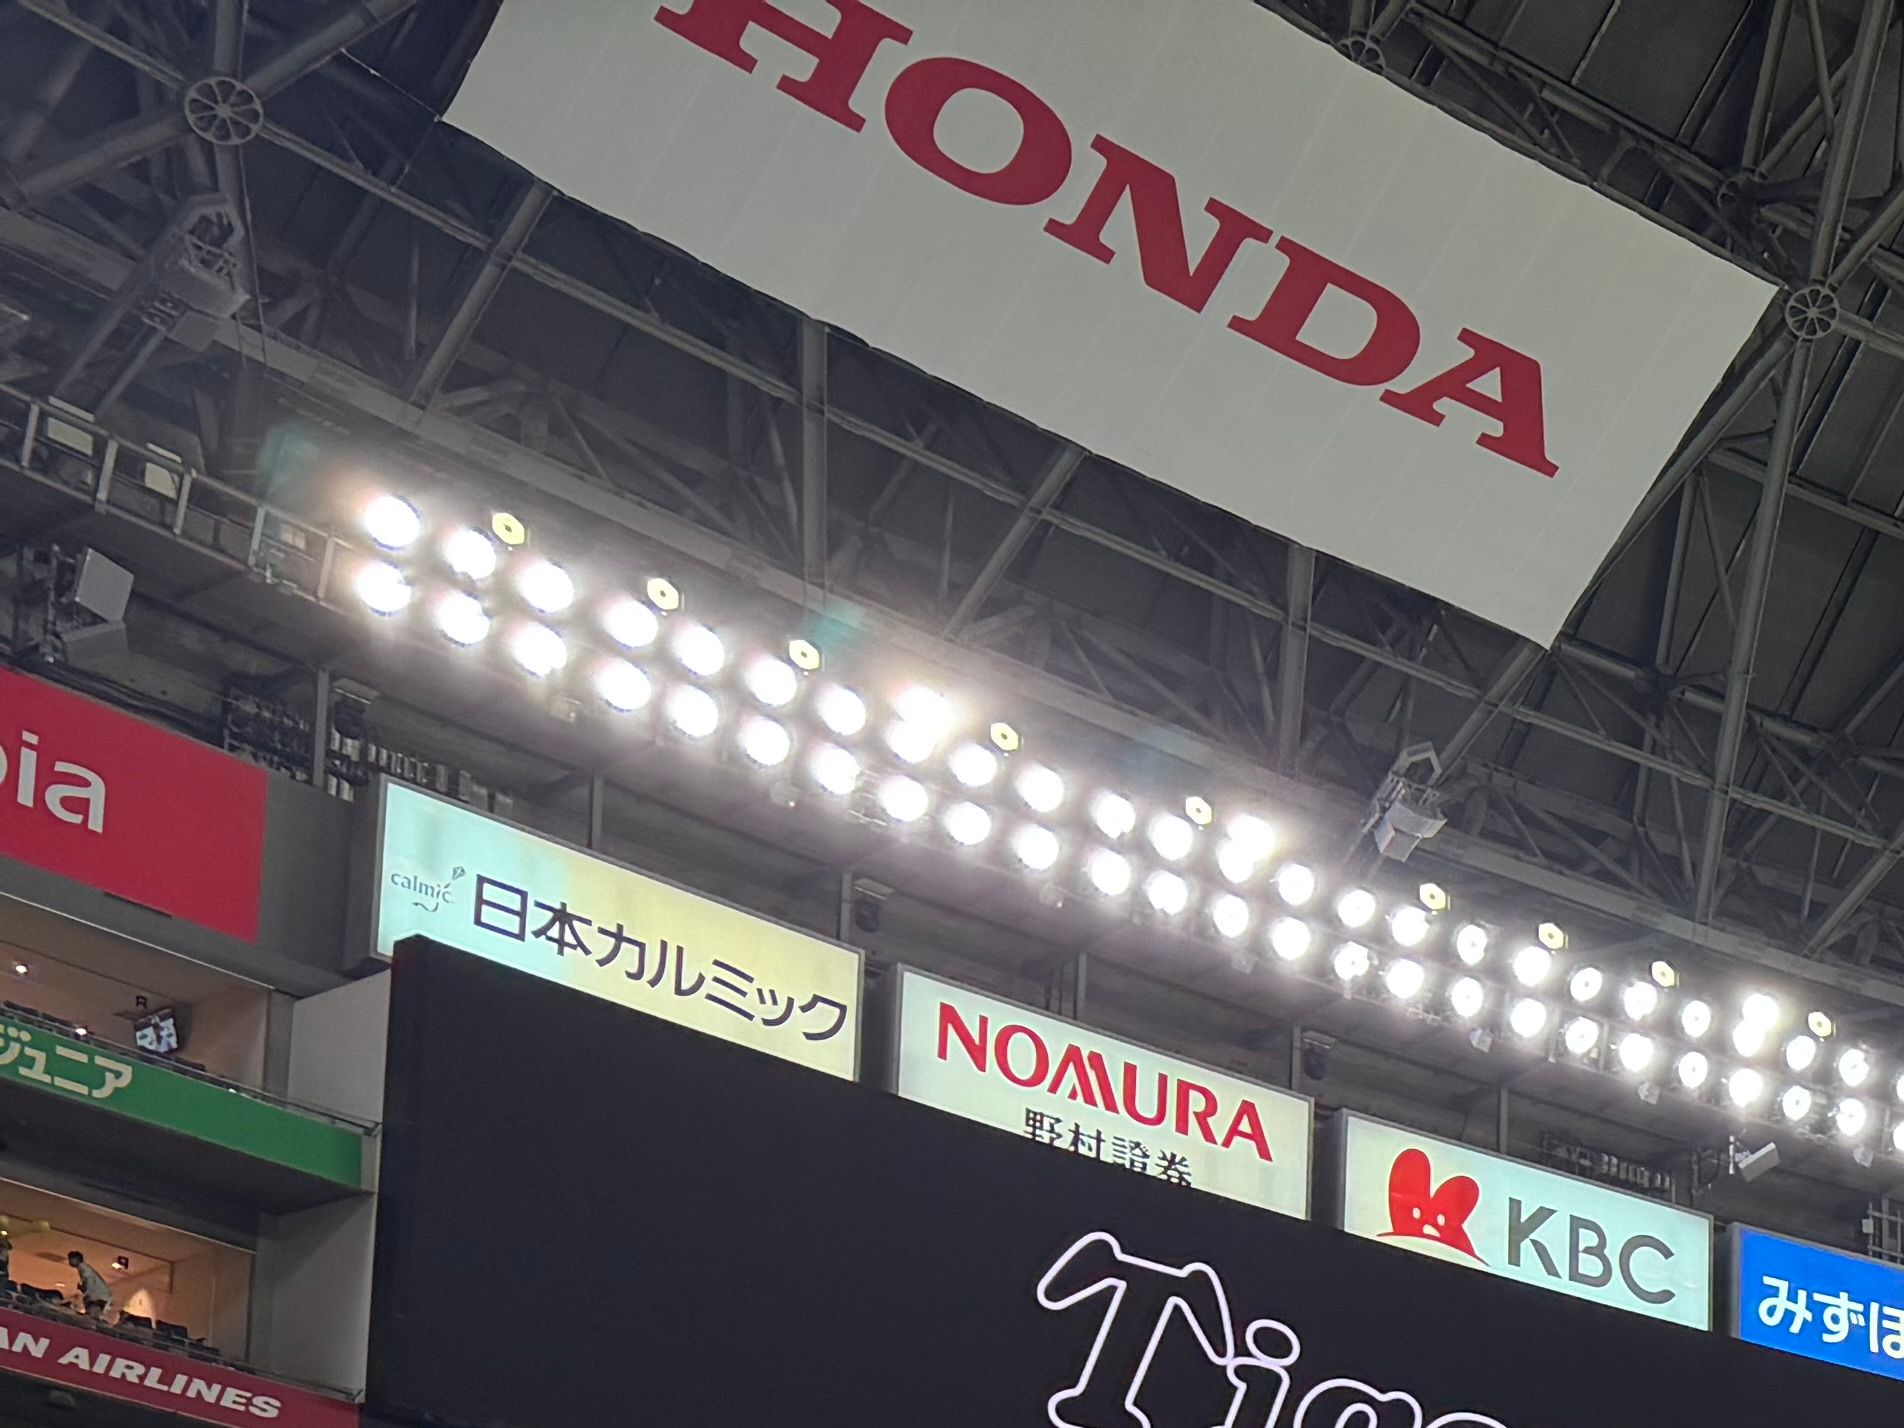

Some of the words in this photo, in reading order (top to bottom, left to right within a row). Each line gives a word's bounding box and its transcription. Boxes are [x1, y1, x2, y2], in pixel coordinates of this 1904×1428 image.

[655, 0, 1560, 478] HONDA
[0, 730, 107, 833] ia
[474, 874, 848, 1042] 日本カルミック
[936, 1002, 1274, 1164] NOMURA
[1507, 1197, 1677, 1304] KBC
[57, 1345, 283, 1420] AIRLINES
